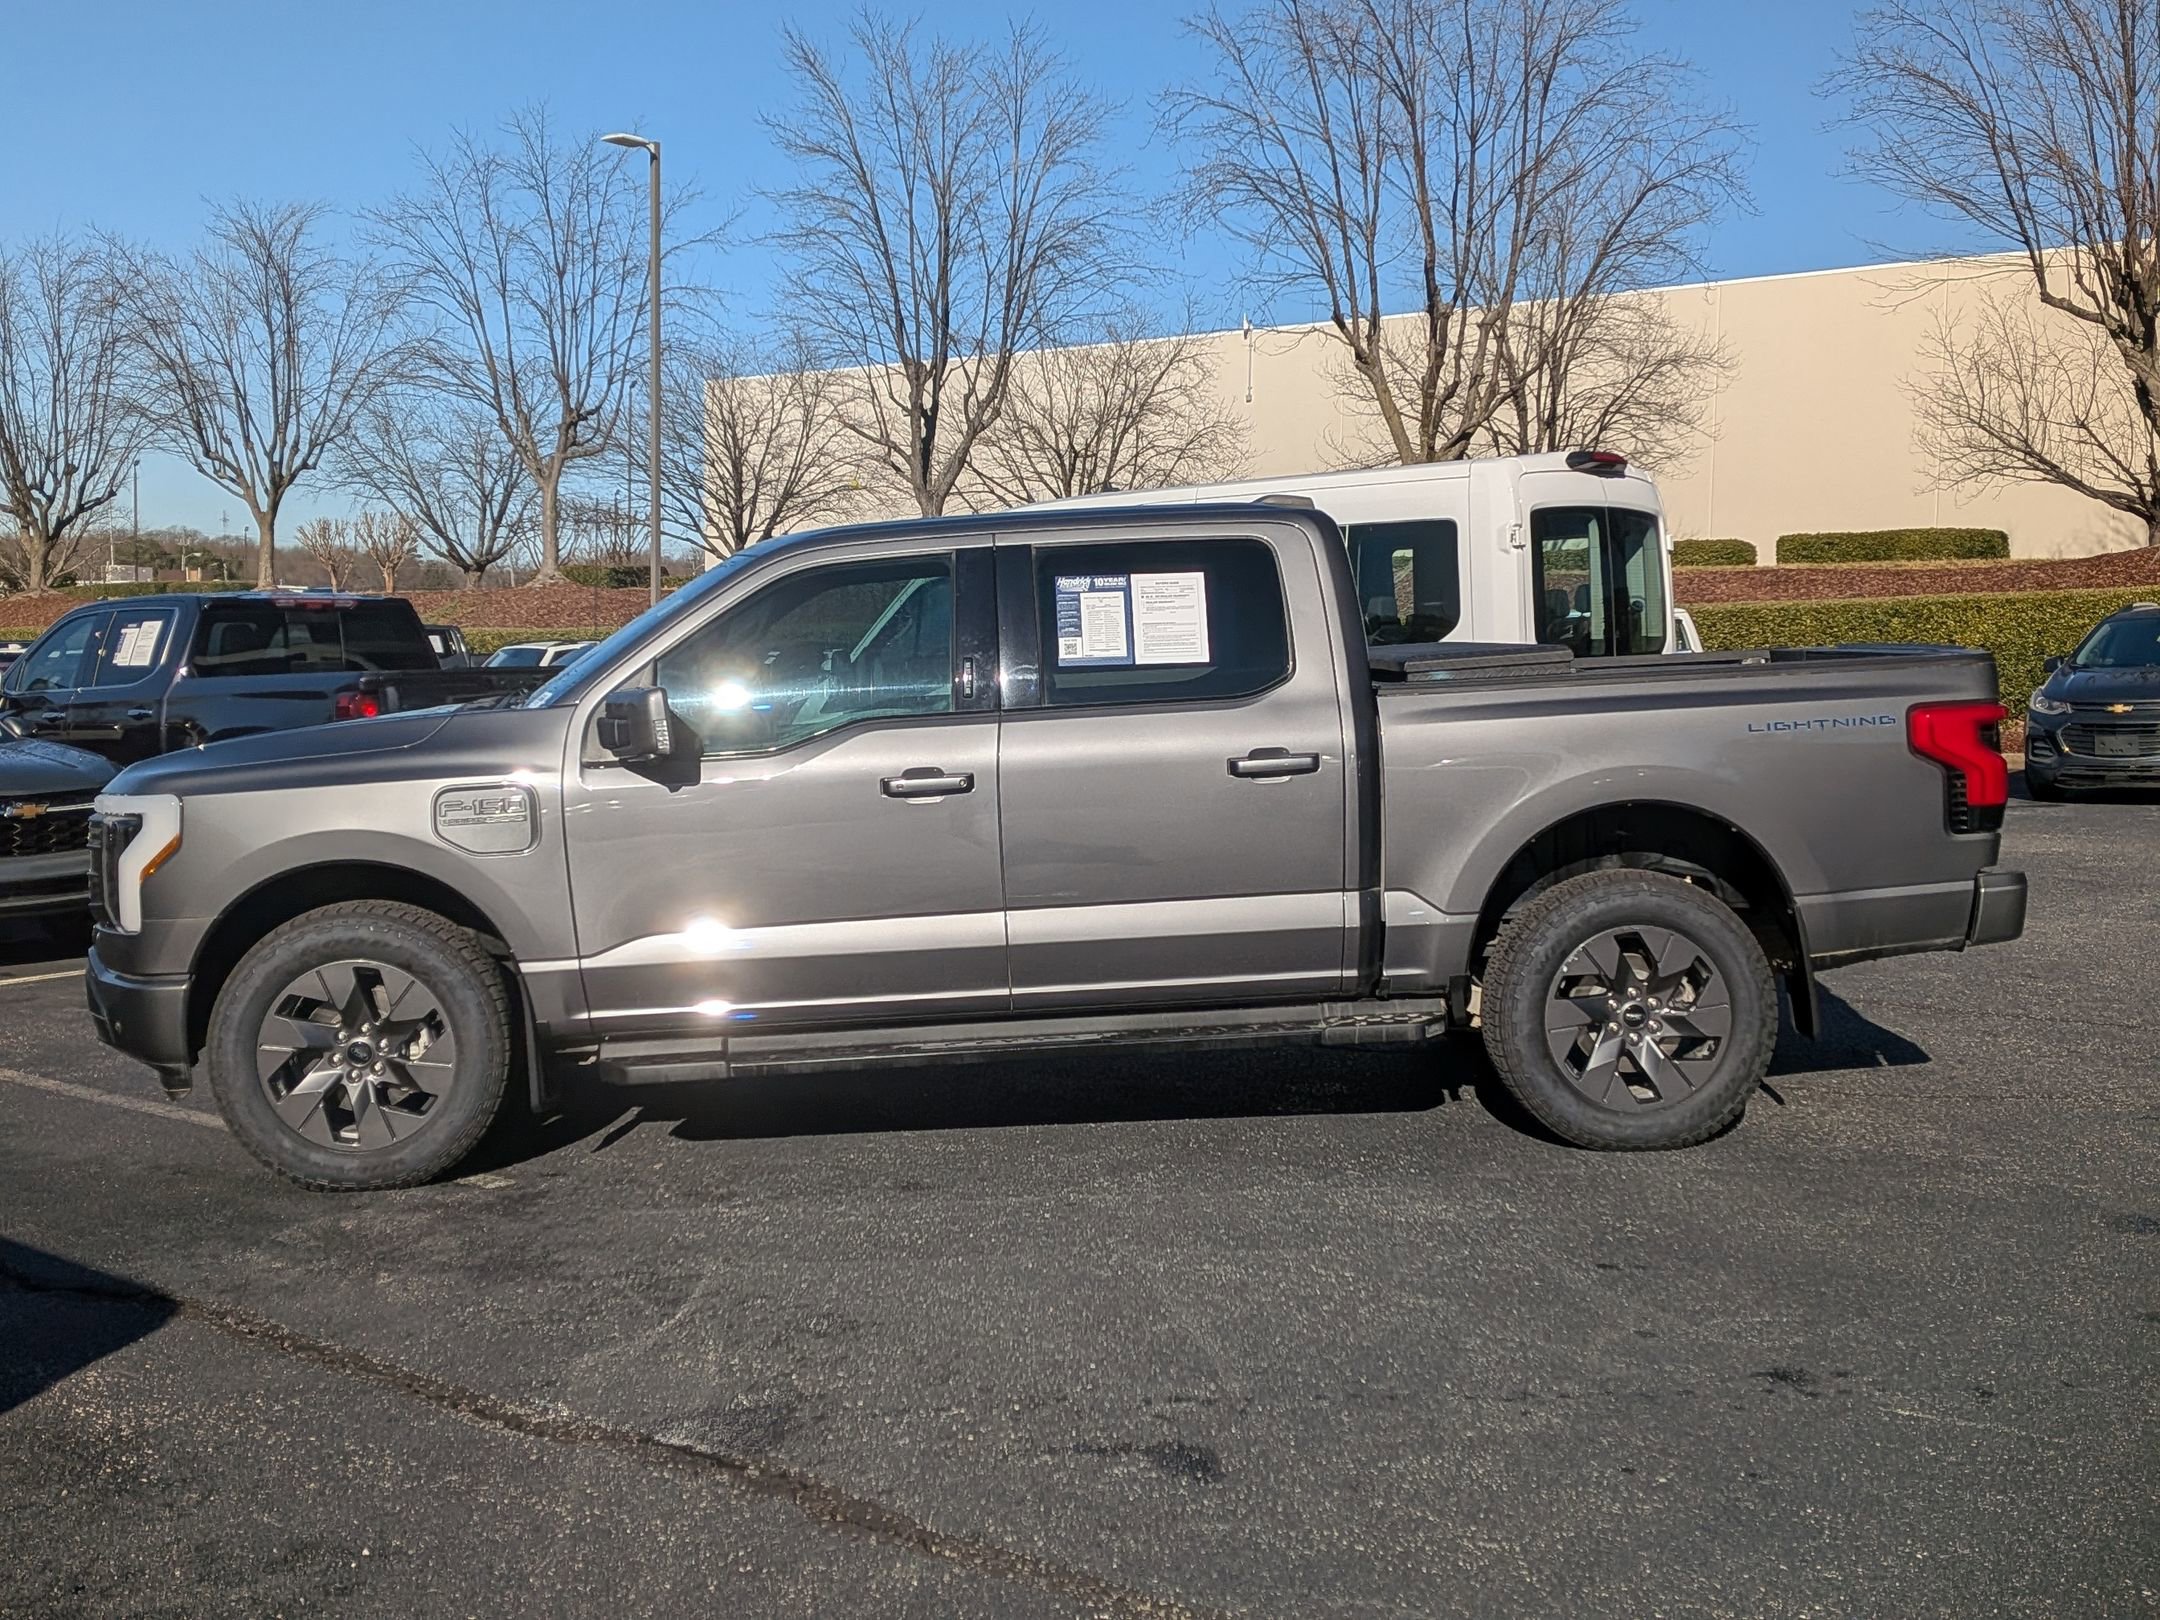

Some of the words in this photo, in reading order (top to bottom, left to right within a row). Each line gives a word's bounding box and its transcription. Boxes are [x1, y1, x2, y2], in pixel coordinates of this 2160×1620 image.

[1093, 577, 1104, 586] 10
[1748, 715, 1897, 733] LIGHTNING
[438, 797, 527, 817] F-150
